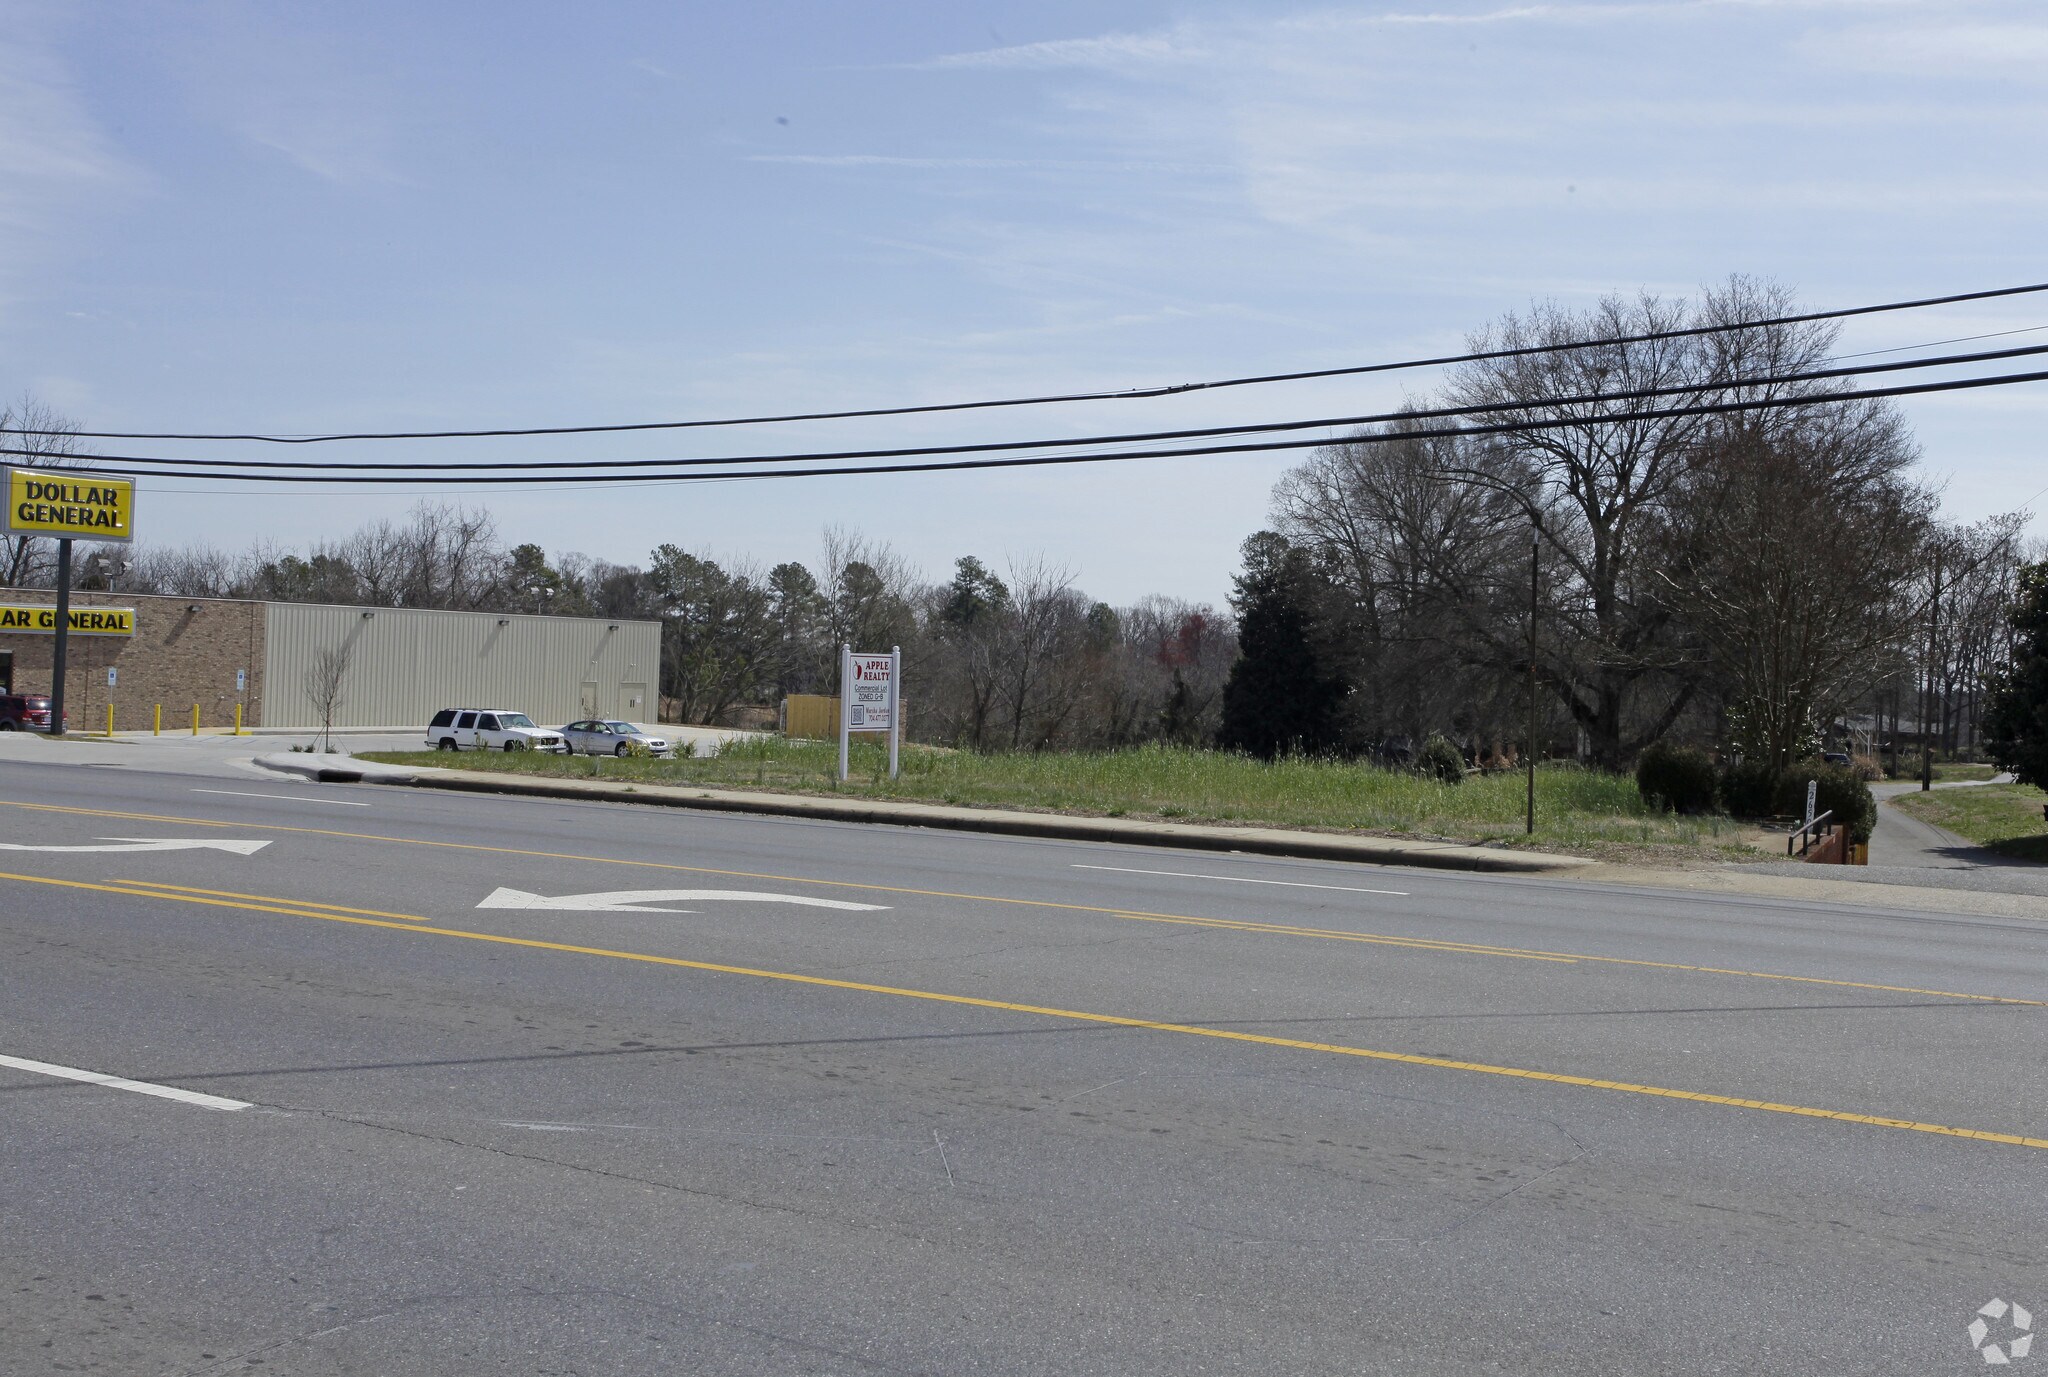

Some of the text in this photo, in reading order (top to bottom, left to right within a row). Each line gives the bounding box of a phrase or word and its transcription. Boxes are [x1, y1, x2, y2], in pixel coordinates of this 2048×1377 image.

[26, 481, 118, 507] DOLLAR
[18, 502, 123, 528] GENERAL
[39, 611, 128, 630] GNERAL
[865, 661, 889, 670] APPLE
[863, 672, 890, 681] REALTY
[855, 684, 879, 692] Commercial
